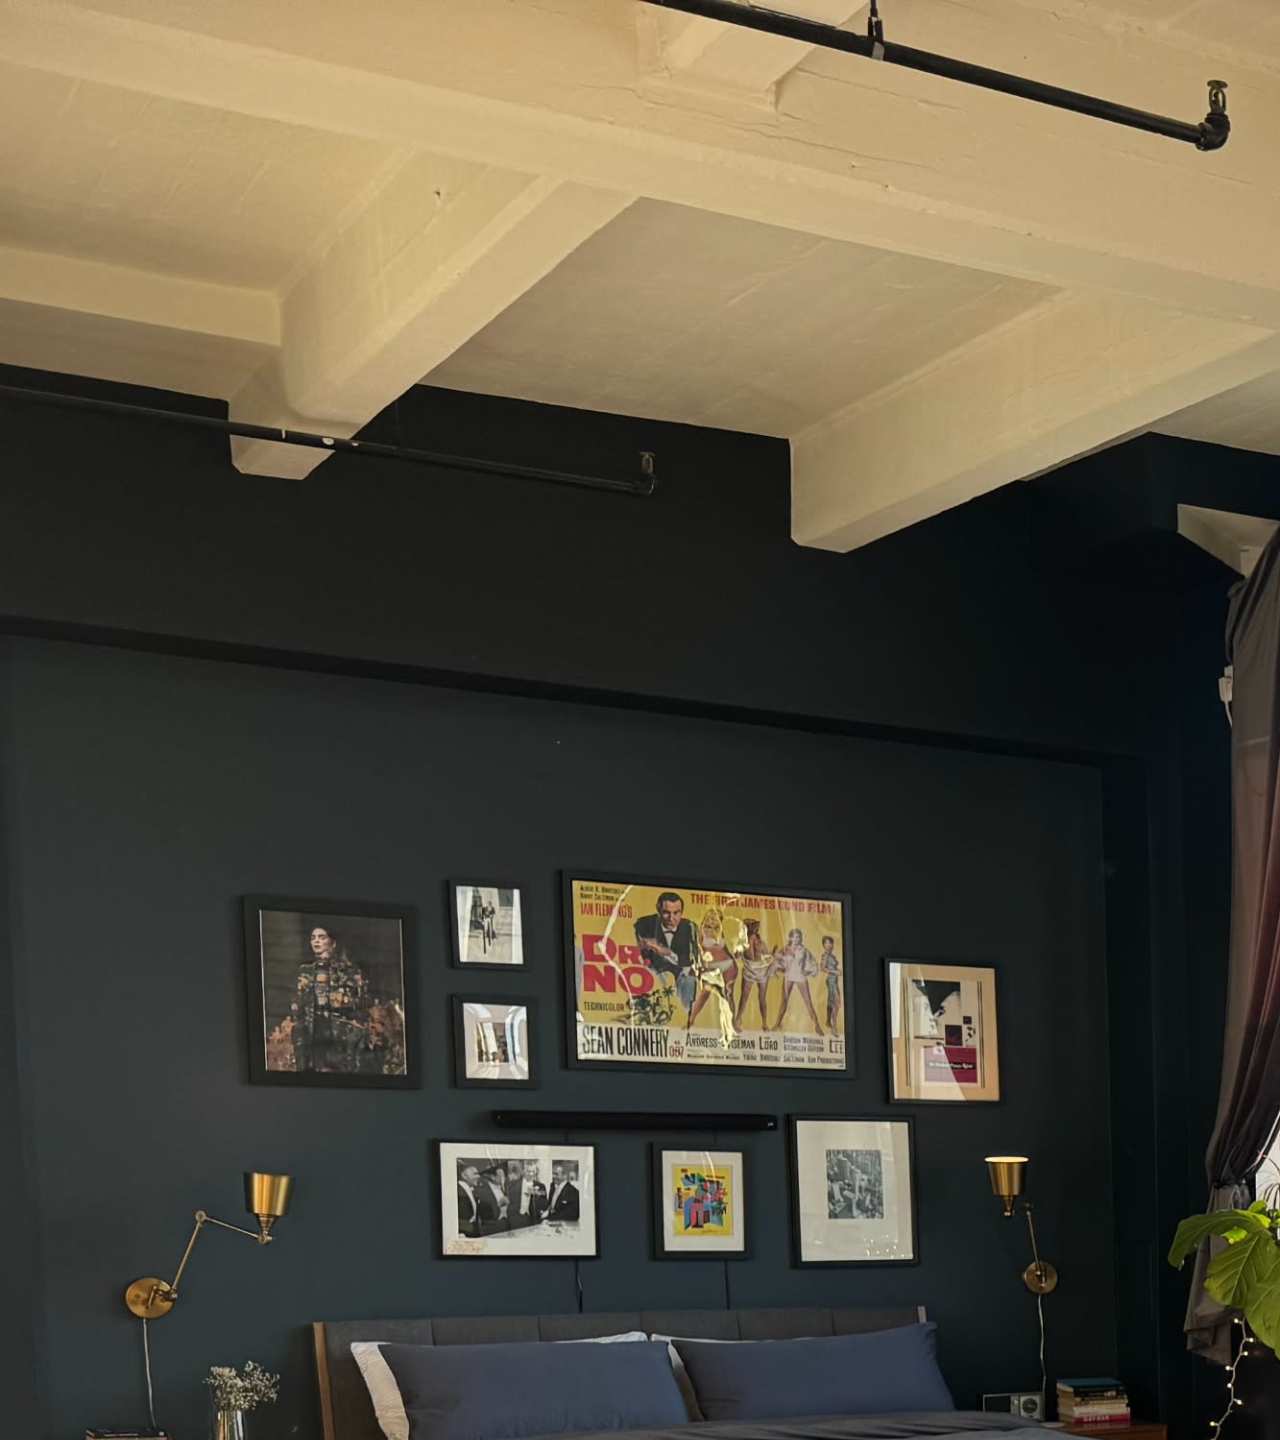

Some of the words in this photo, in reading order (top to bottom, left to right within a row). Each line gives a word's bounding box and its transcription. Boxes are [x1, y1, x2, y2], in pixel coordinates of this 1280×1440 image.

[690, 893, 709, 905] THE
[582, 964, 655, 996] NO
[582, 1025, 614, 1055] SEAN
[617, 1027, 669, 1057] CONNERY
